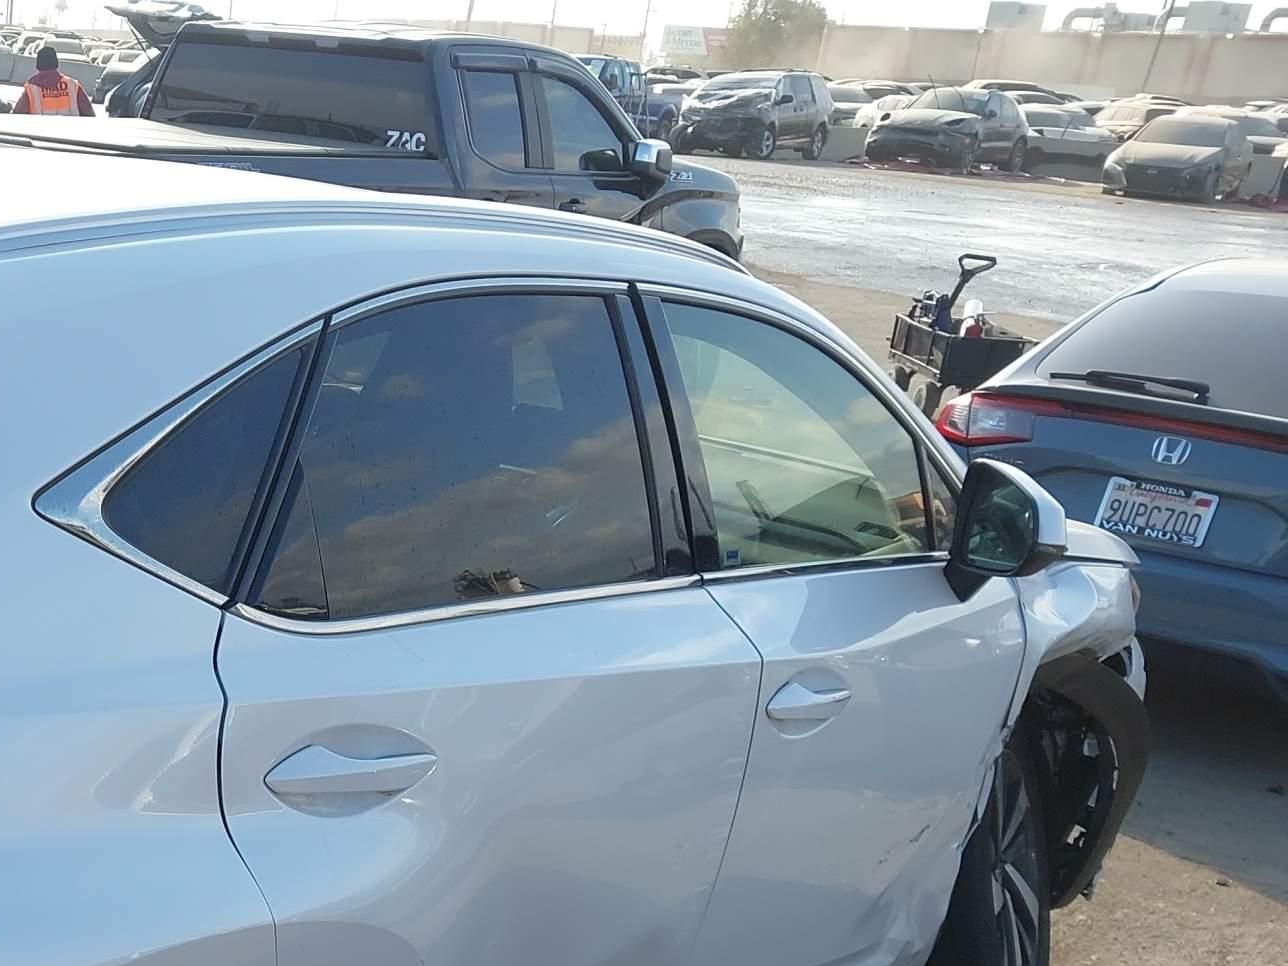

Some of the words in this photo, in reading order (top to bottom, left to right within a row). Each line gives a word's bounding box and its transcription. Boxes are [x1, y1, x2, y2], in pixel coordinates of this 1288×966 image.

[1140, 482, 1186, 497] HONDA
[1108, 498, 1202, 535] 9UPC700
[1102, 519, 1139, 534] VAN
[1144, 530, 1195, 545] NUYS
